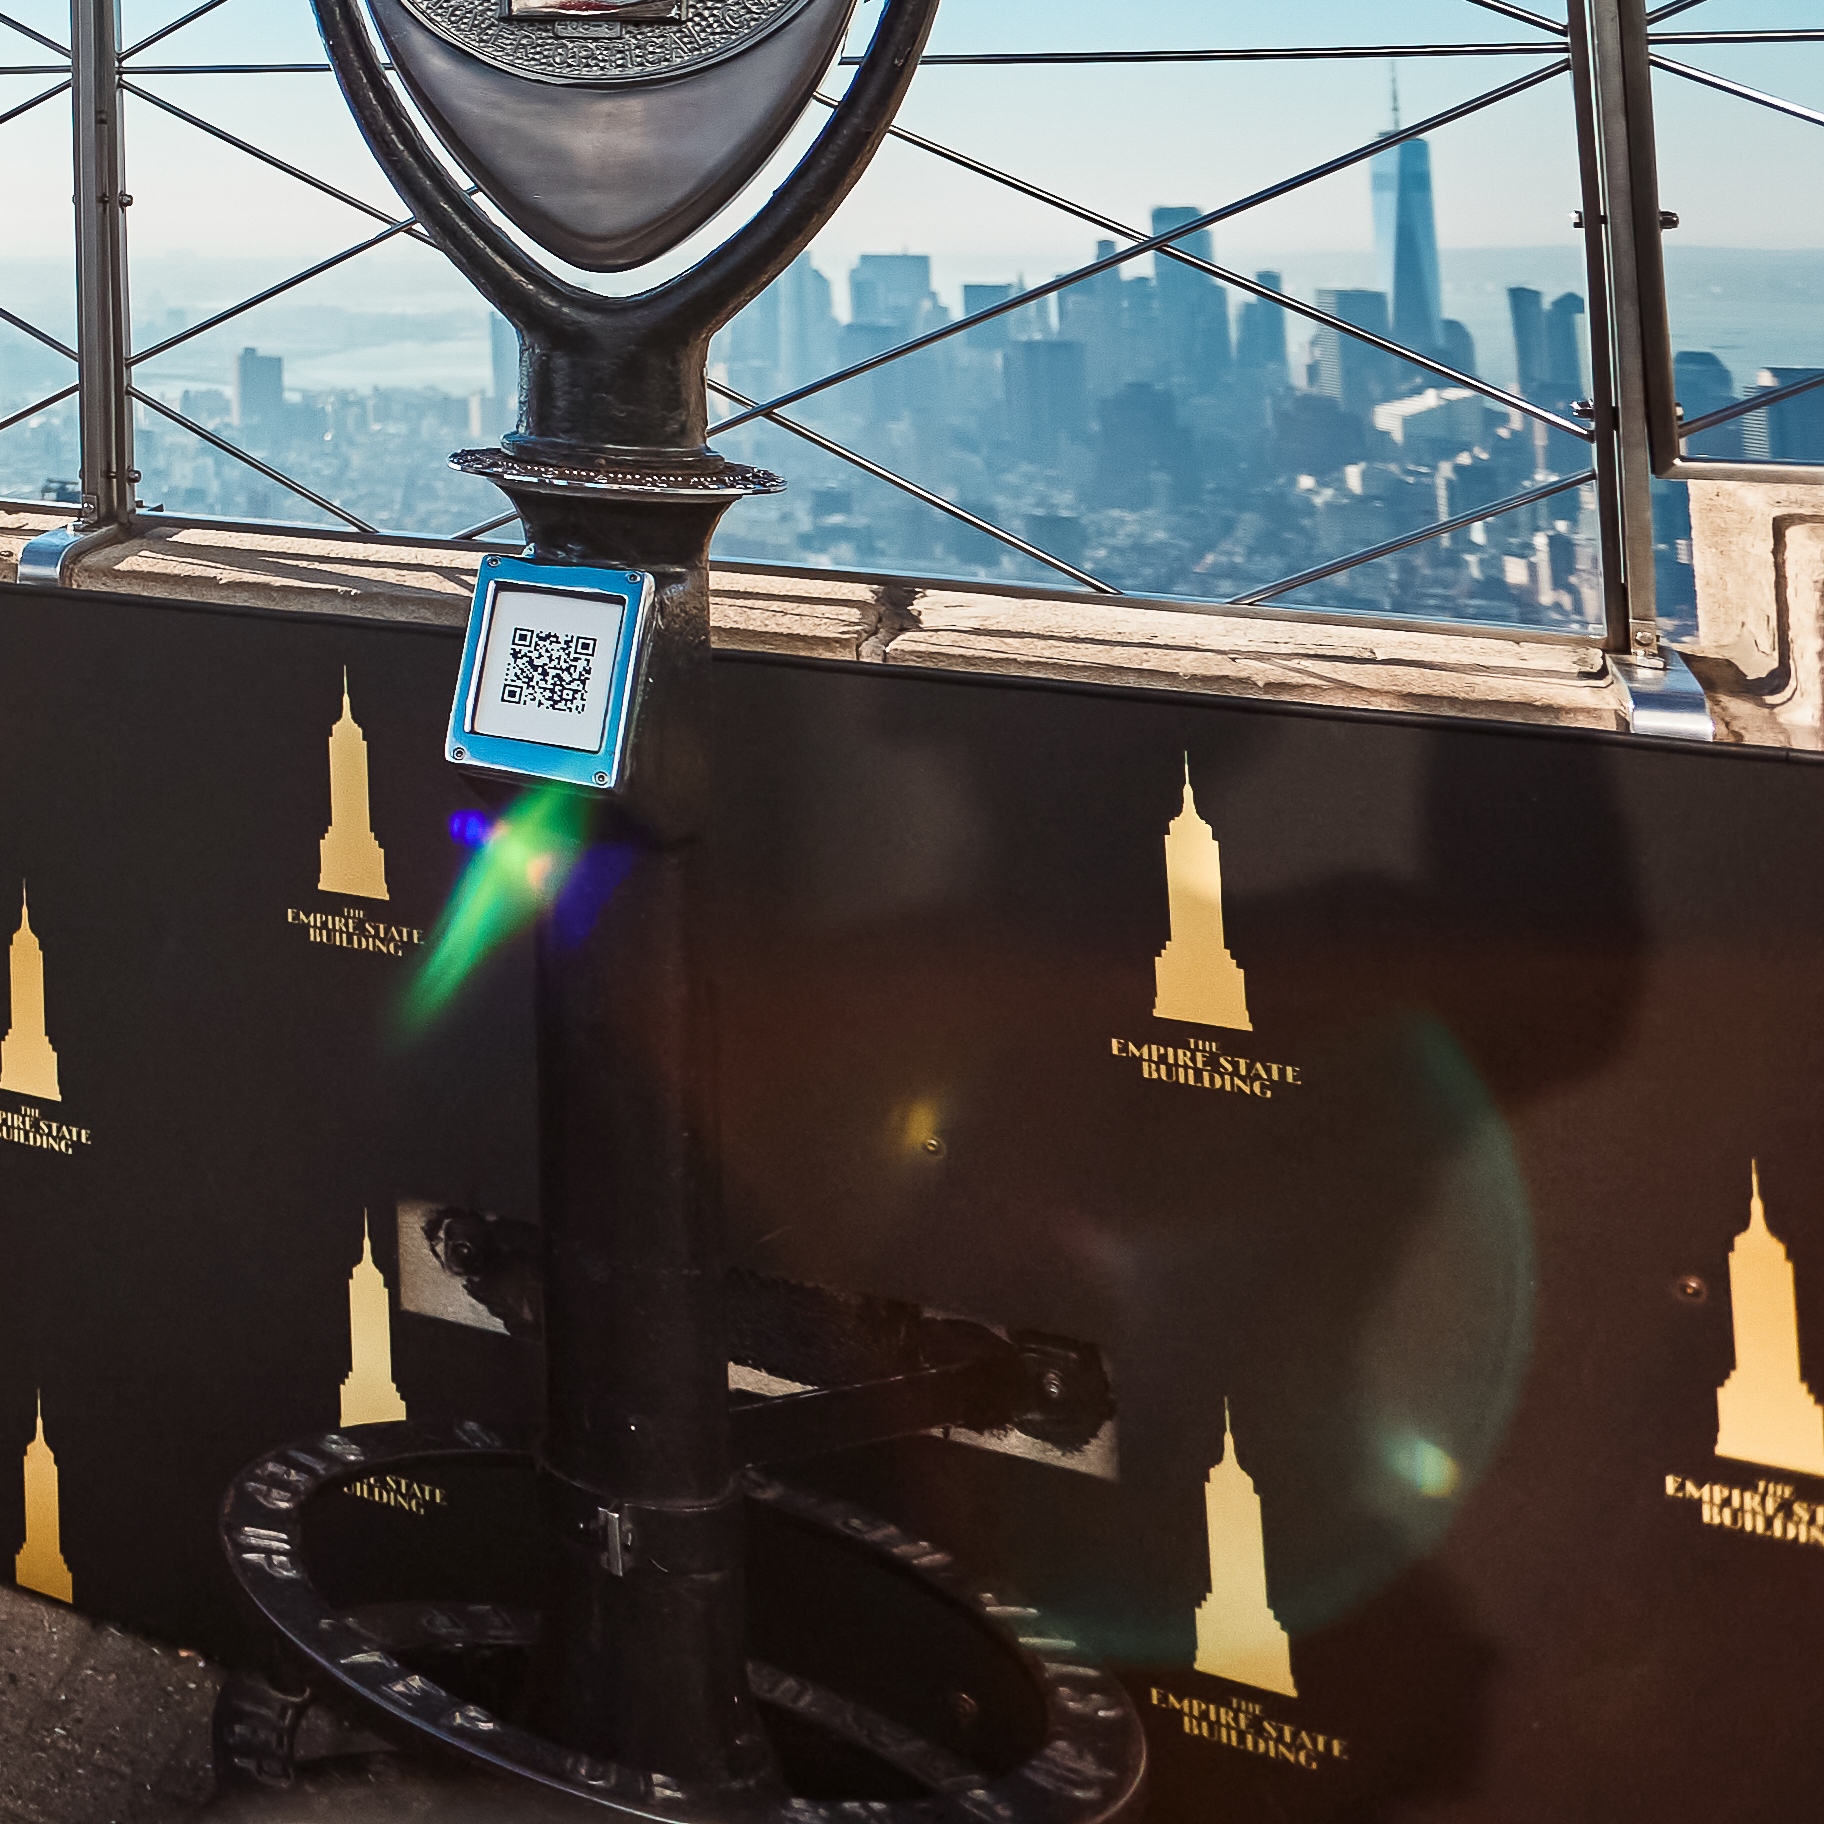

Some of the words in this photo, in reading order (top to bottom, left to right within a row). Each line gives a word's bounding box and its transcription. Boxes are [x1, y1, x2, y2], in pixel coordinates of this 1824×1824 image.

[287, 908, 360, 934] EMPIRE
[365, 922, 425, 945] STATE
[343, 907, 367, 919] THE
[309, 927, 403, 957] BUILDING
[1111, 1037, 1211, 1070] EMPIRE
[1219, 1055, 1302, 1085] STATE
[1187, 1037, 1221, 1053] THE
[1142, 1060, 1272, 1098] BUILDING
[20, 1105, 41, 1118] THE
[39, 1120, 92, 1145] STATE
[386, 1475, 448, 1506] STATE
[1665, 1474, 1782, 1517] EMPIRE
[1150, 1687, 1253, 1731] EMPIRE
[1262, 1720, 1350, 1761] STATE
[1183, 1715, 1317, 1771] BUILDING
